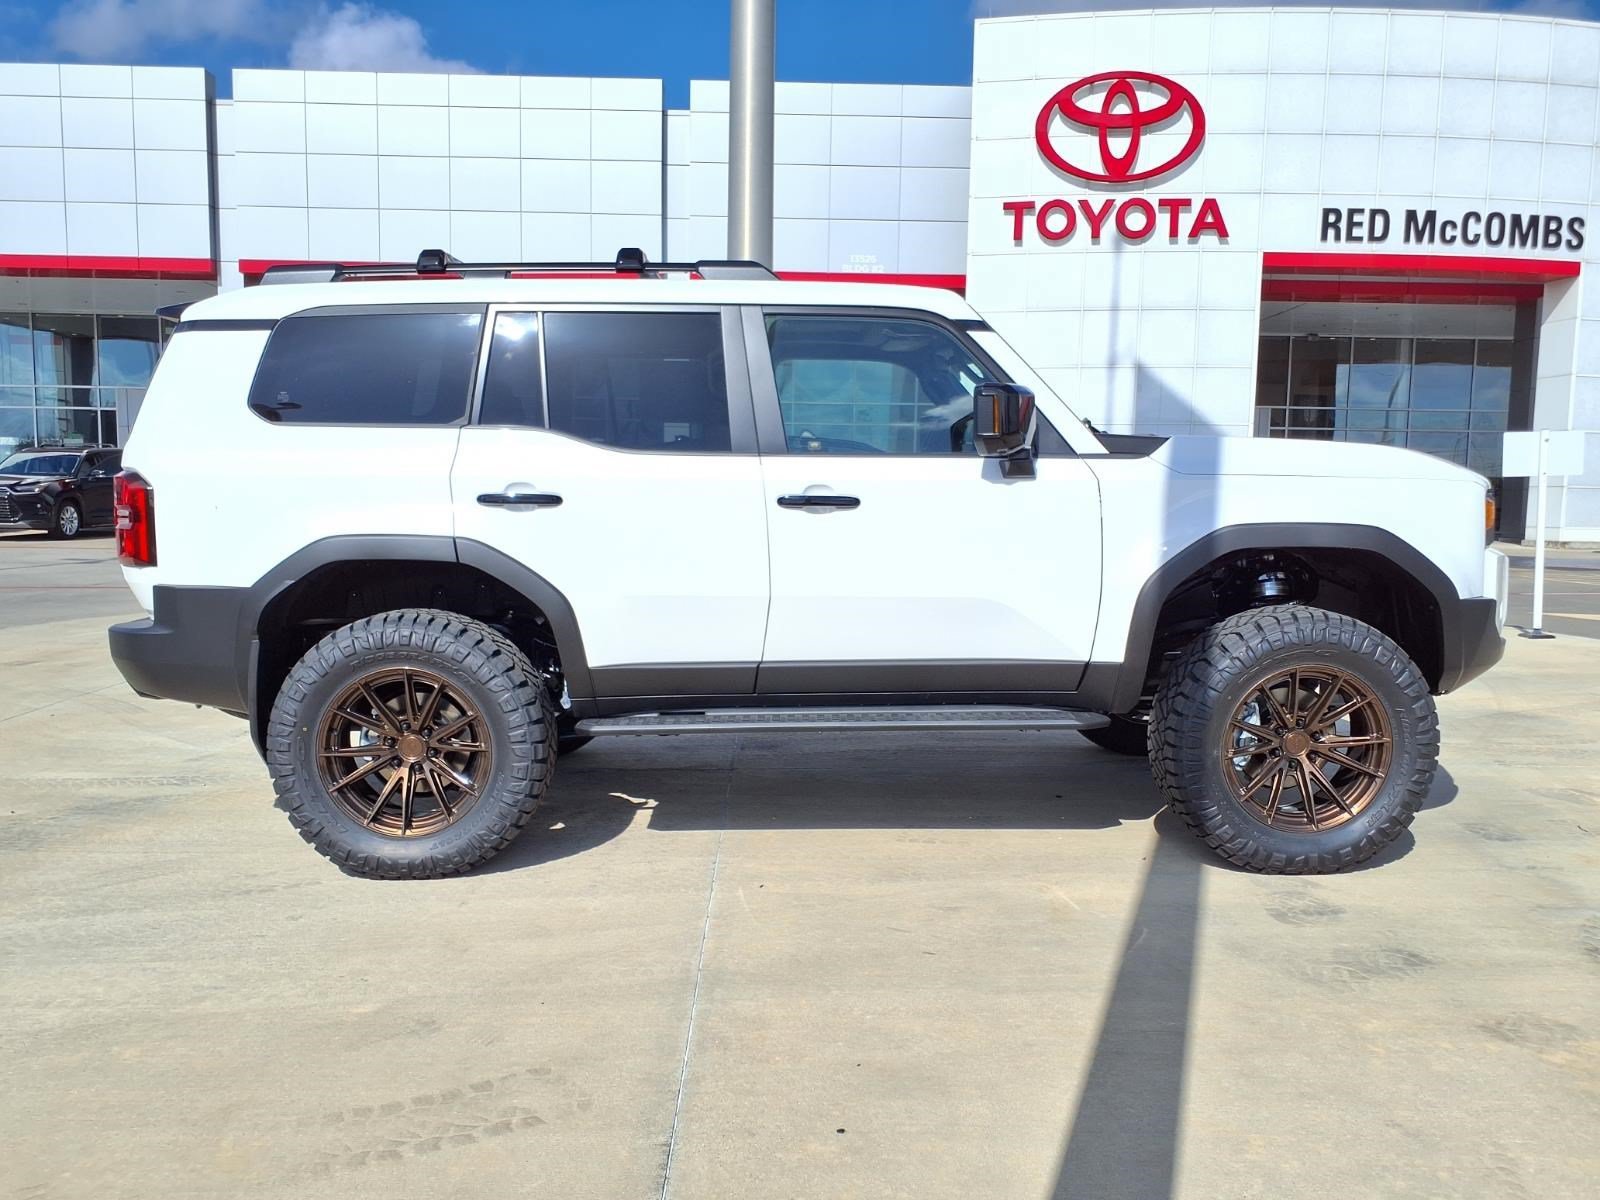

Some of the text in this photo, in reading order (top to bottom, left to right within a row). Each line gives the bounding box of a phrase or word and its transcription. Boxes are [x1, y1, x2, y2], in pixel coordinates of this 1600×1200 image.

[1003, 198, 1229, 243] TOYOTA
[1321, 208, 1586, 250] RED McCOMBS
